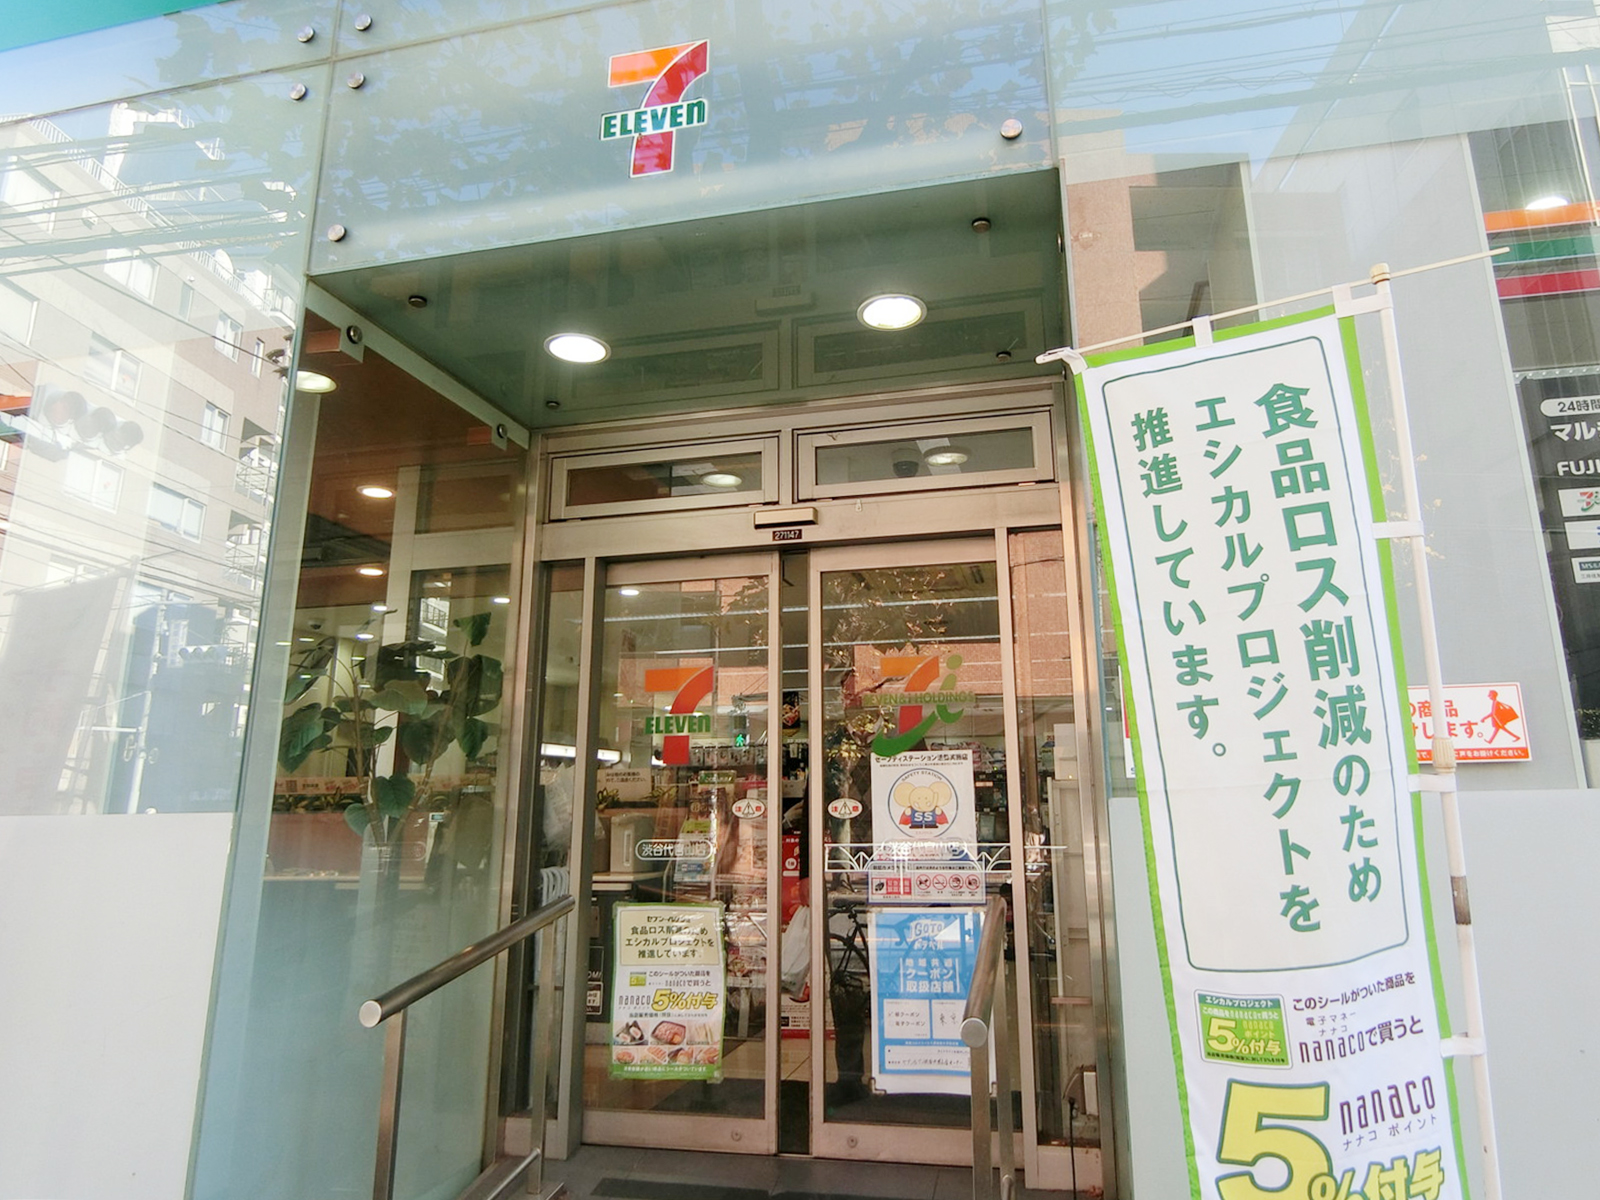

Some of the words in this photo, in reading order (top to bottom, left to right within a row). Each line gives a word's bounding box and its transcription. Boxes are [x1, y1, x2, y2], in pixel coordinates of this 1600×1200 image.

[608, 40, 710, 178] 7
[1550, 420, 1600, 442] マル
[774, 530, 799, 540] 271147
[1131, 407, 1226, 758] 推進しています。
[1255, 382, 1383, 905] 食品ロス削減のため
[1195, 396, 1322, 934] エシカルプロジェクトを
[645, 666, 714, 765] 7
[914, 690, 975, 704] HOLDINGS
[914, 812, 933, 822] SS
[906, 968, 953, 980] クーポン
[1292, 971, 1416, 1012] このシールがついた商品を
[618, 994, 651, 1006] nanaco
[651, 988, 719, 1012] 5%付与
[1306, 1011, 1356, 1027] 電子マネー
[1299, 1015, 1424, 1063] nanacoで買うと
[1339, 1075, 1436, 1135] nanaco
[1216, 1078, 1445, 1200] 5%付与
[1343, 1130, 1378, 1152] ナナコ
[1388, 1113, 1438, 1138] ポイント
